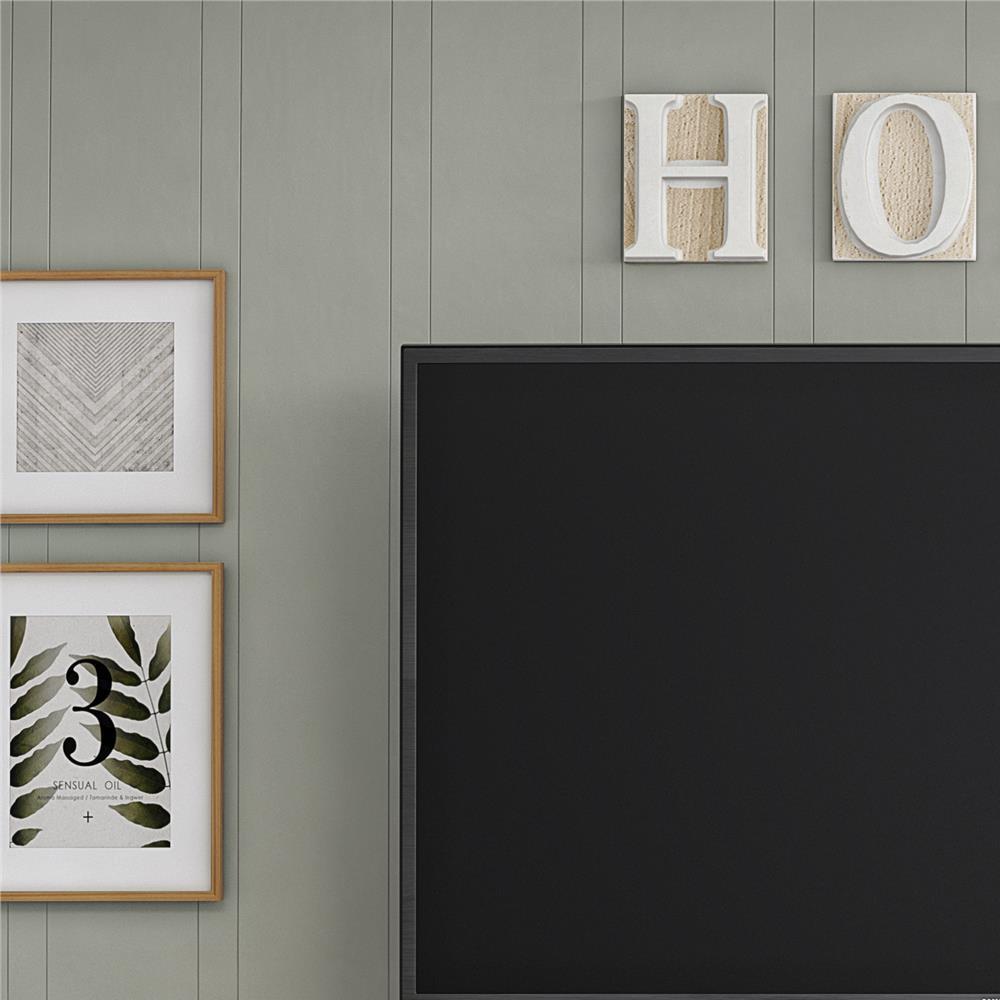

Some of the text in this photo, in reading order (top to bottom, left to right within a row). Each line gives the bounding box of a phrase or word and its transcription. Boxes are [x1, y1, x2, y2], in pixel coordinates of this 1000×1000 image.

[62, 658, 117, 767] 3
[52, 780, 122, 791] SENSUAL OIL
